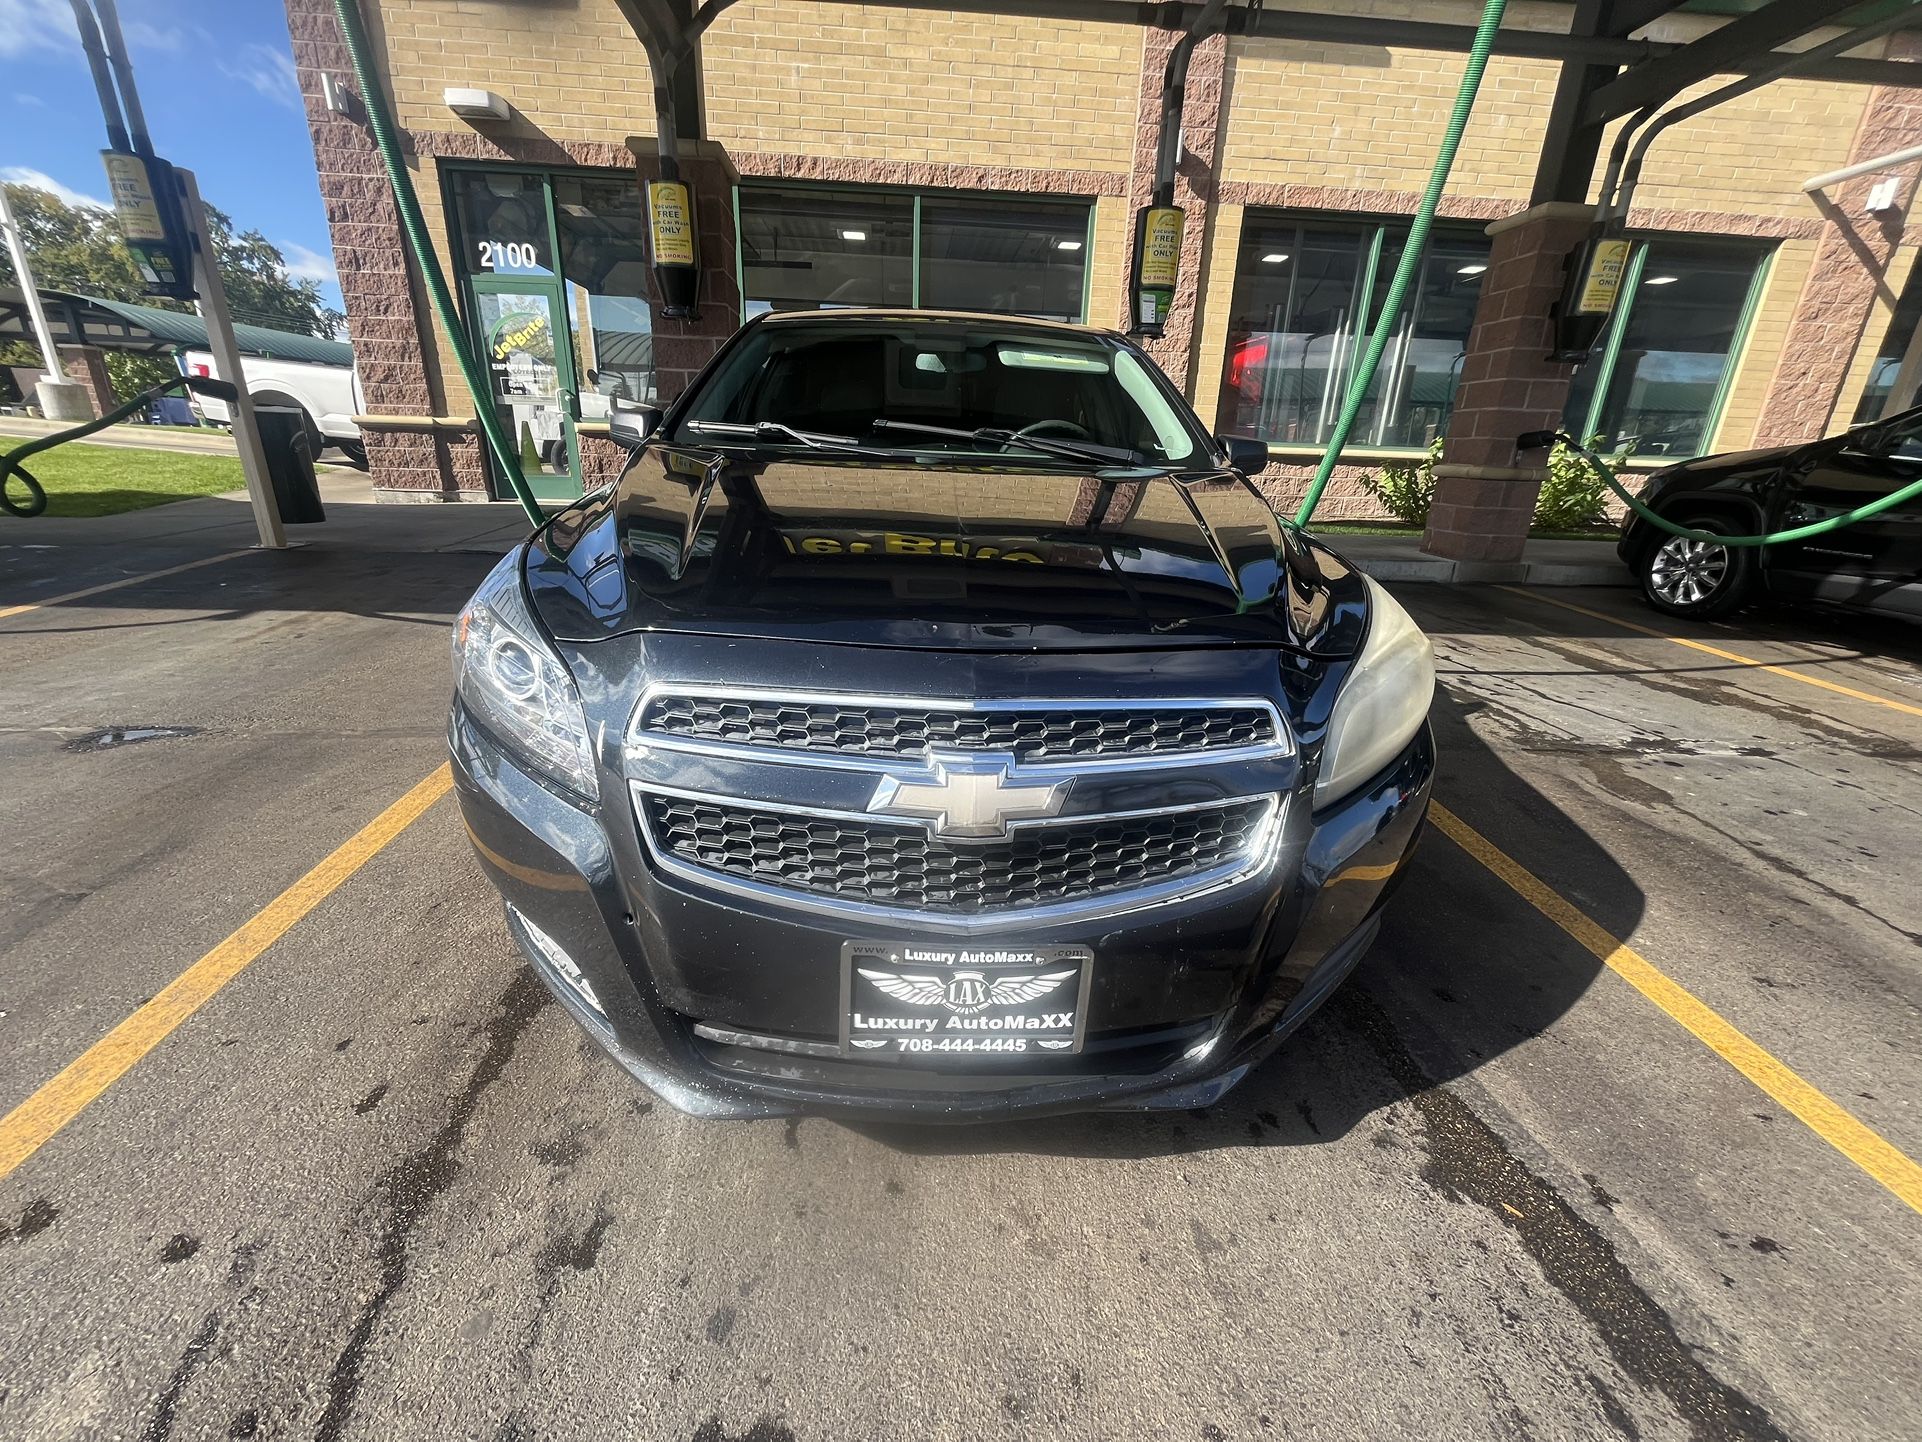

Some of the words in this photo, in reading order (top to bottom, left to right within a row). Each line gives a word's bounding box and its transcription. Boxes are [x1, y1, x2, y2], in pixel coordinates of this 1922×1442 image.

[654, 203, 683, 211] Vacuums
[657, 210, 680, 219] FREE
[659, 226, 681, 234] ONLY
[1154, 235, 1175, 243] FREE
[478, 241, 536, 268] 2100
[494, 315, 545, 360] JetBrite
[853, 946, 889, 954] www.
[904, 948, 957, 964] Luxury
[959, 950, 1034, 963] AutoMaxx
[949, 980, 987, 1005] LAX
[853, 1013, 939, 1032] Luxury
[945, 1012, 1074, 1030] AutoMaXX
[898, 1038, 1027, 1052] 708-444-4445
